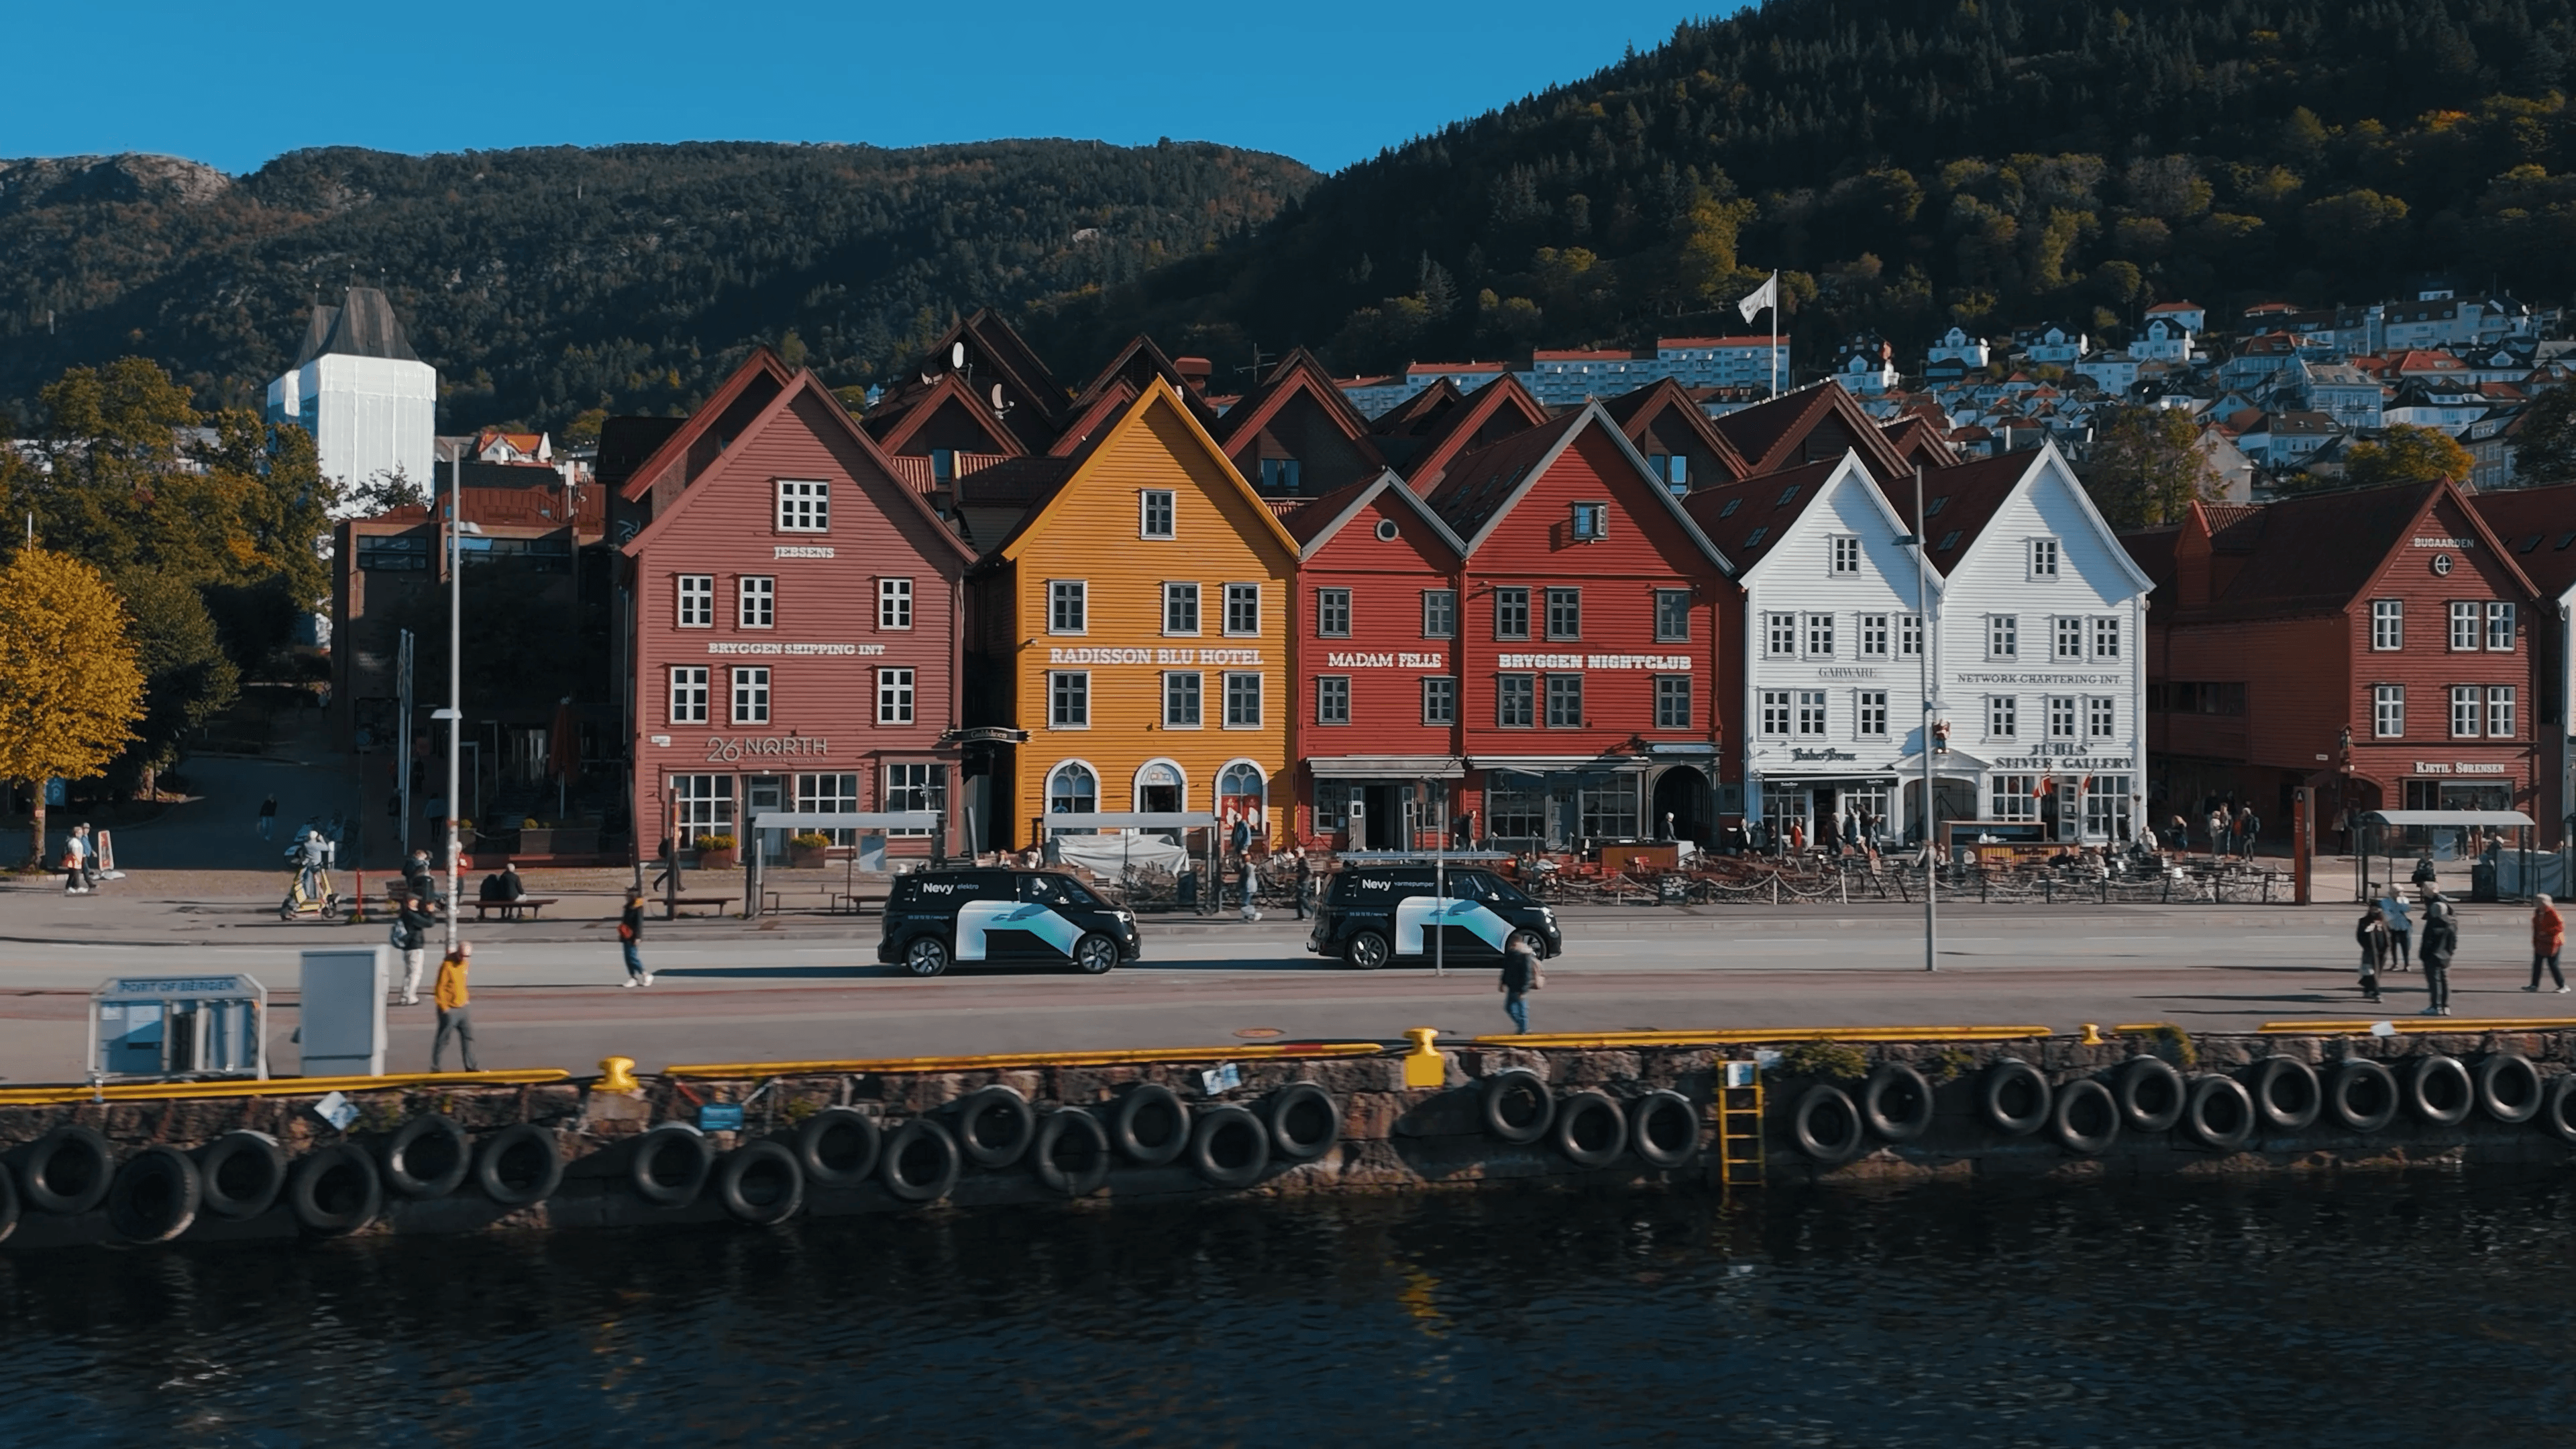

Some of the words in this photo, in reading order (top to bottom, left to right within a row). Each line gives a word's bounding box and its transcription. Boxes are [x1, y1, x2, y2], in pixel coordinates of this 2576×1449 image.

[773, 547, 835, 559] JEBSENS
[708, 643, 782, 654] BRYGGEN
[784, 644, 855, 655] SHIPPING
[858, 645, 885, 655] INT
[1050, 648, 1152, 664] RADISSON
[1157, 649, 1195, 664] BLU
[1199, 649, 1264, 665] HOTEL
[1328, 652, 1394, 667] MADAM
[1397, 653, 1442, 667] FELLE
[1498, 654, 1584, 669] BRYGGEN
[1587, 655, 1692, 669] NIGHTCLUB
[1819, 667, 1878, 678] GARWARE
[1957, 674, 2017, 684] NETWORK
[2019, 674, 2097, 684] CHARTERING
[706, 737, 740, 762] 26
[744, 737, 828, 755] NORTH
[2062, 757, 2132, 769] GALLERY
[922, 882, 954, 895] Nevy
[1362, 879, 1391, 892] Nevy
